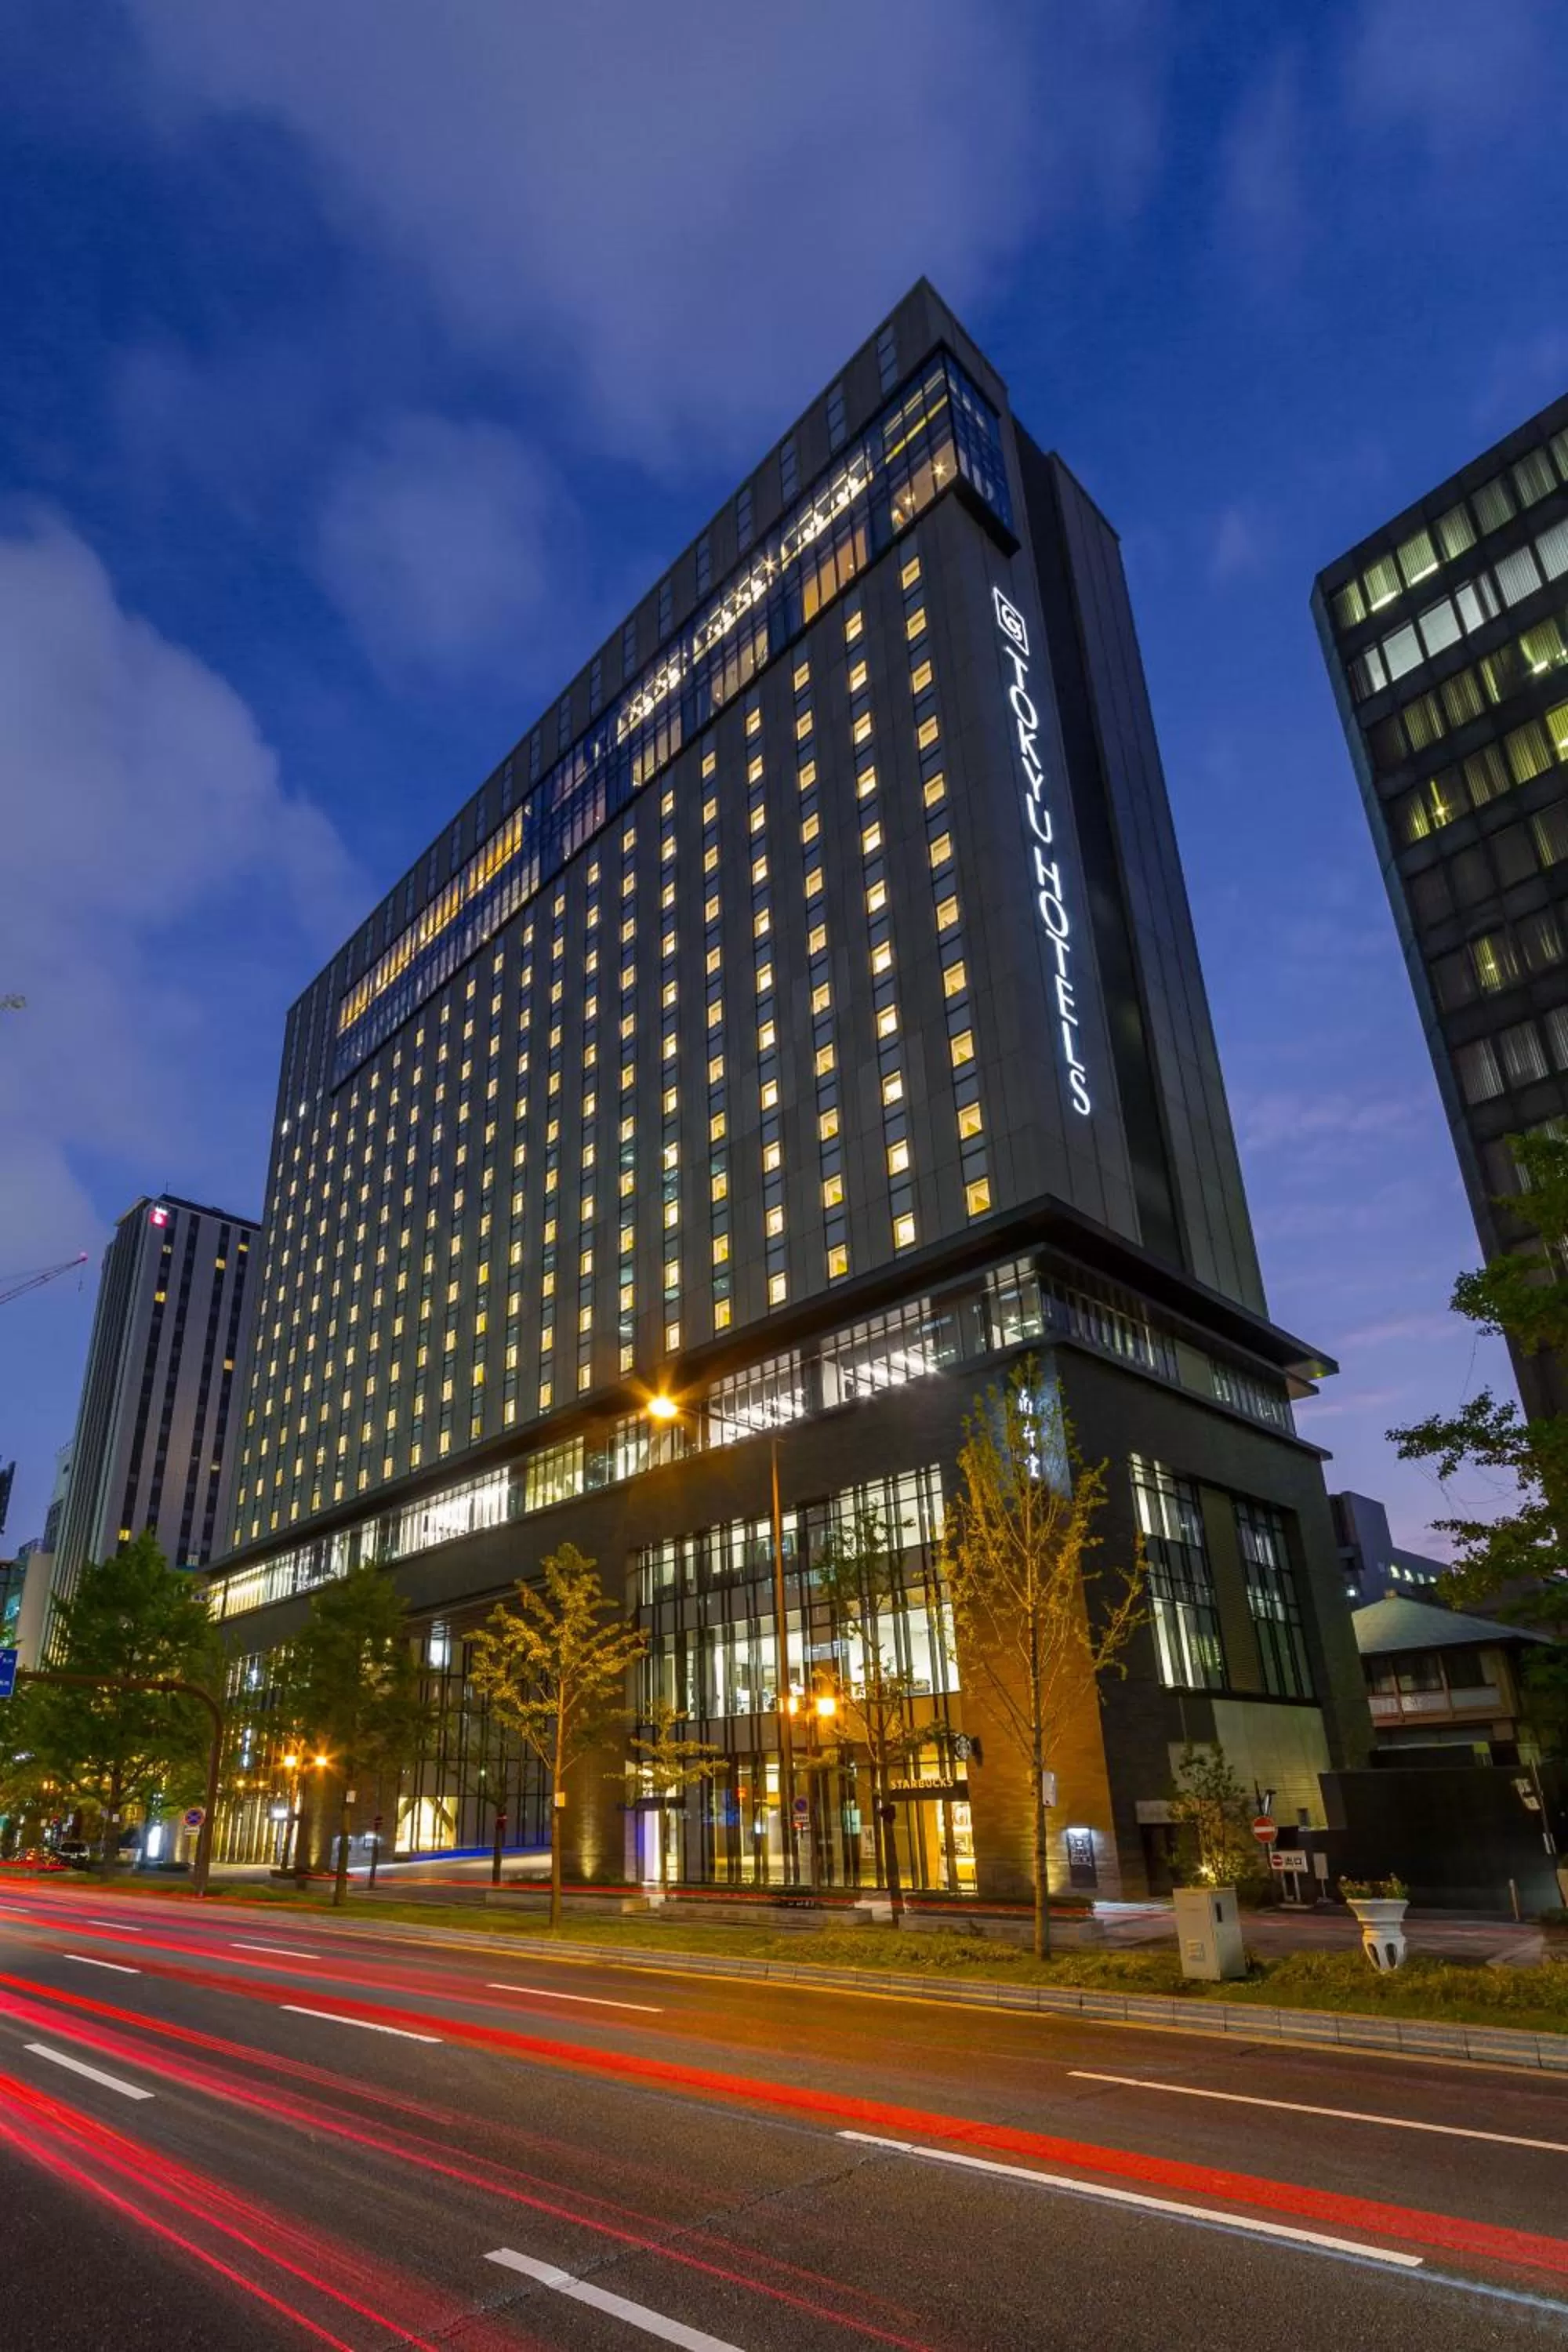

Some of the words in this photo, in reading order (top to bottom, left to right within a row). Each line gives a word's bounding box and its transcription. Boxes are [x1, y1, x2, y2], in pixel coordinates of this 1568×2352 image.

[1004, 644, 1053, 844] TOKYU
[1033, 846, 1091, 1116] HOTELS
[890, 1777, 953, 1789] STARBUCKS
